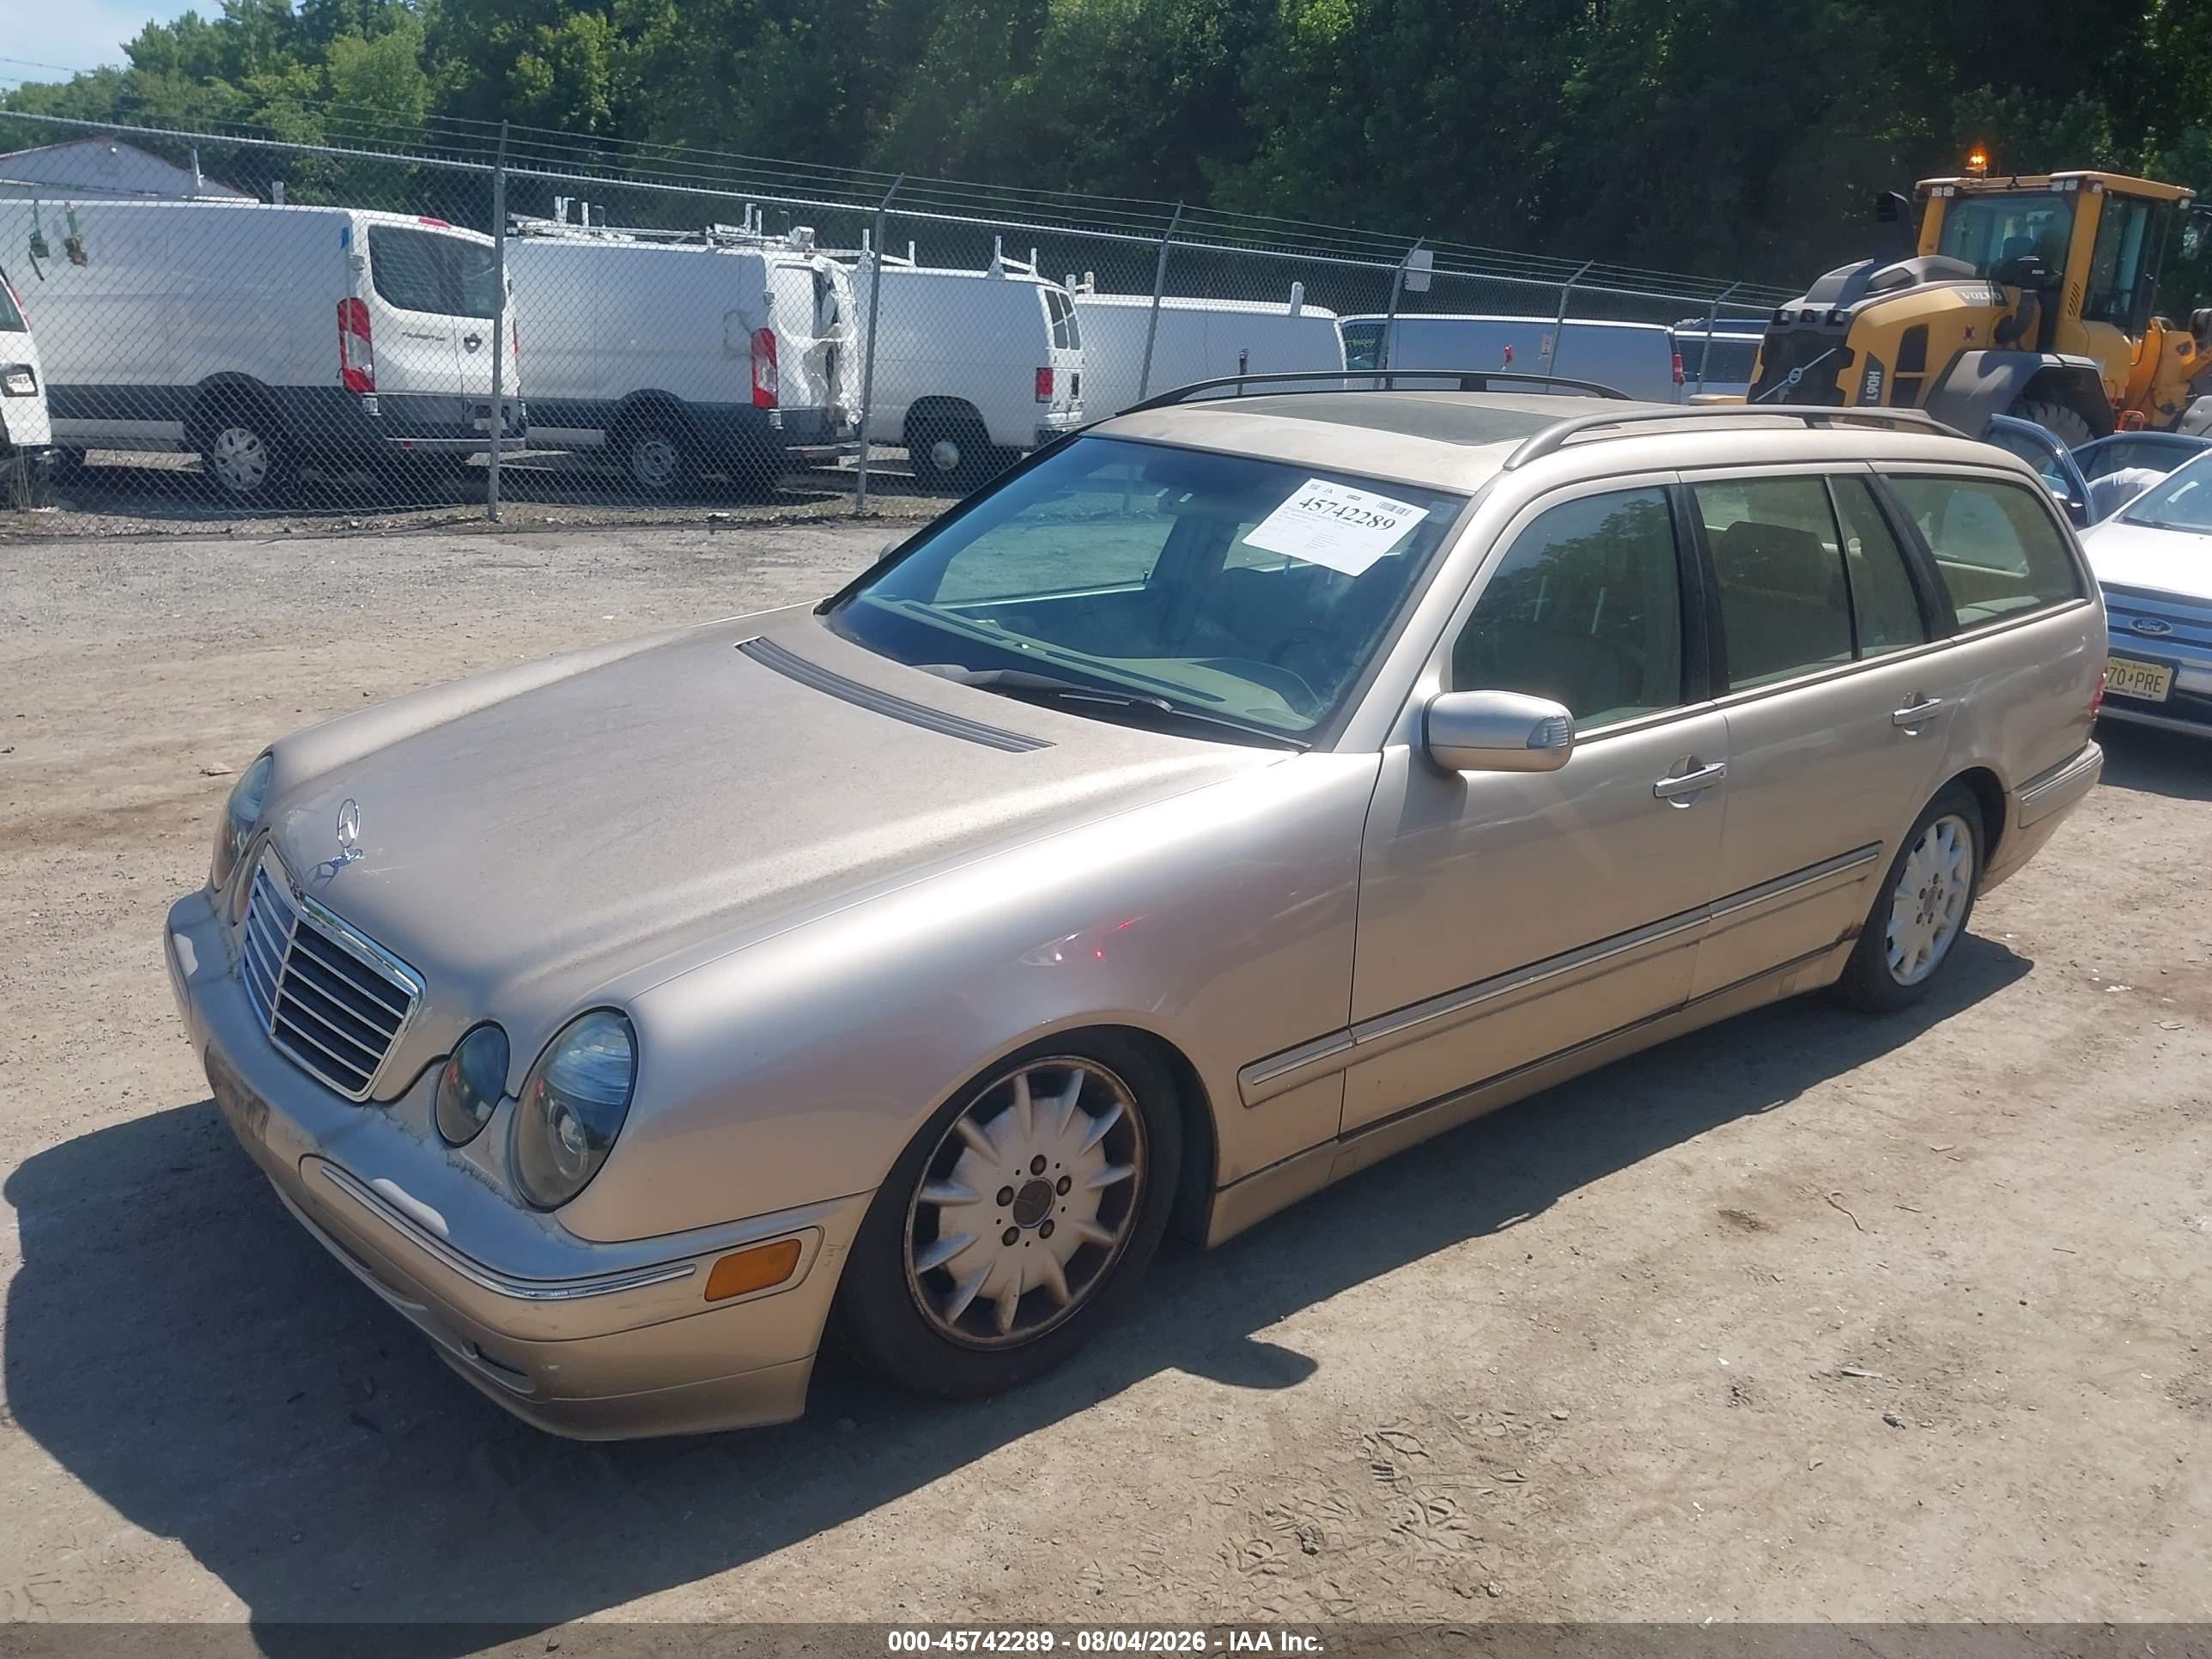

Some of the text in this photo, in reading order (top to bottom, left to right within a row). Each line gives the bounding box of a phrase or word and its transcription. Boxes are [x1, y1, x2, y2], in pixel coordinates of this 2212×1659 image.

[1960, 291, 2003, 301] VOLVO
[1865, 371, 1881, 400] L90H
[1298, 496, 1396, 531] 45742289
[2134, 672, 2165, 694] PRE
